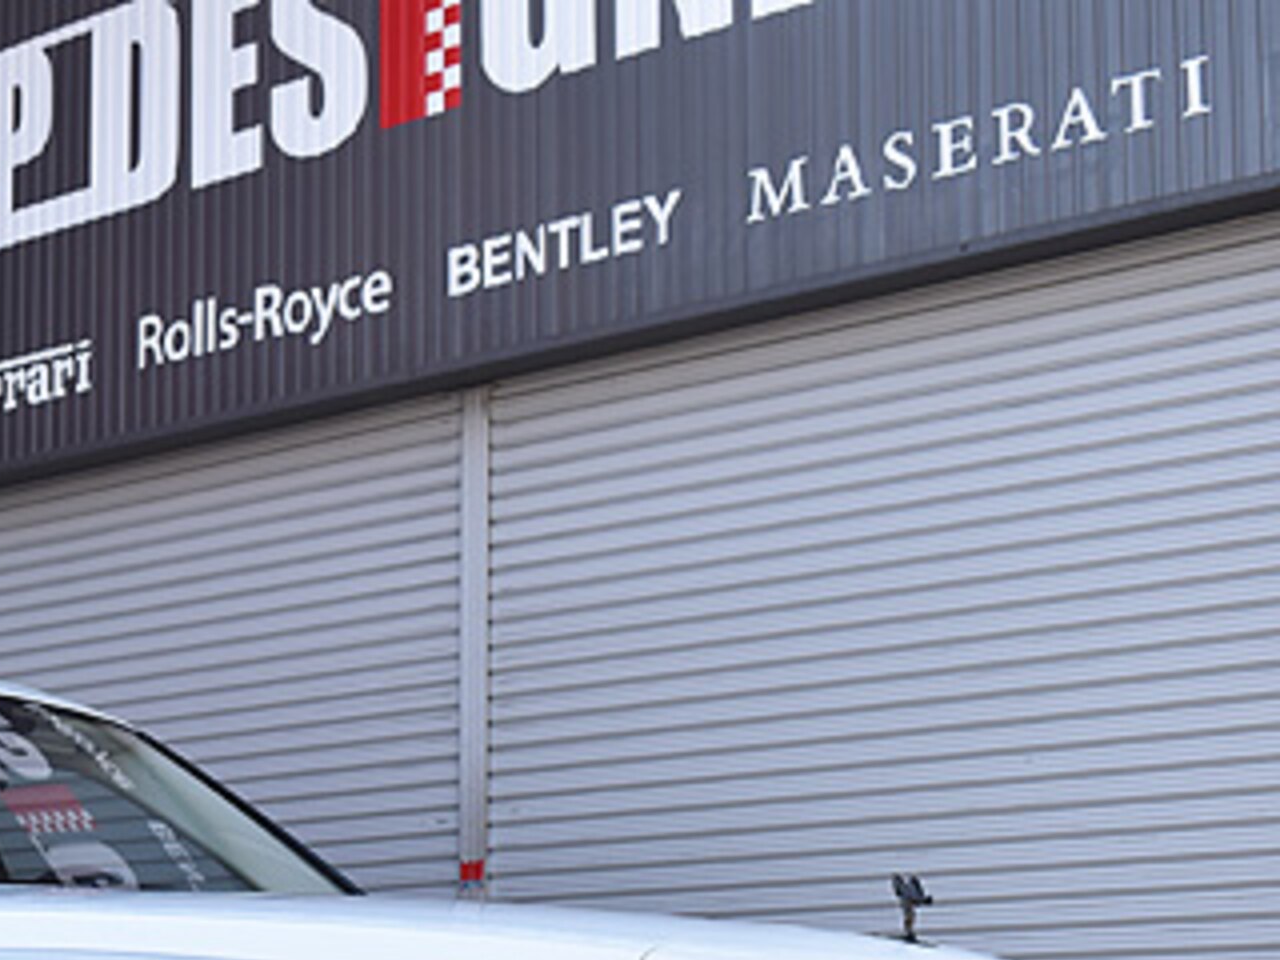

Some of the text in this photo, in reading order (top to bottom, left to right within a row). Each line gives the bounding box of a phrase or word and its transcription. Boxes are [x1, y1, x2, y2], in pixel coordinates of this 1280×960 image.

[137, 270, 393, 370] Rolls-Royce
[447, 188, 682, 297] BENTLEY
[745, 54, 1213, 224] MASERATI
